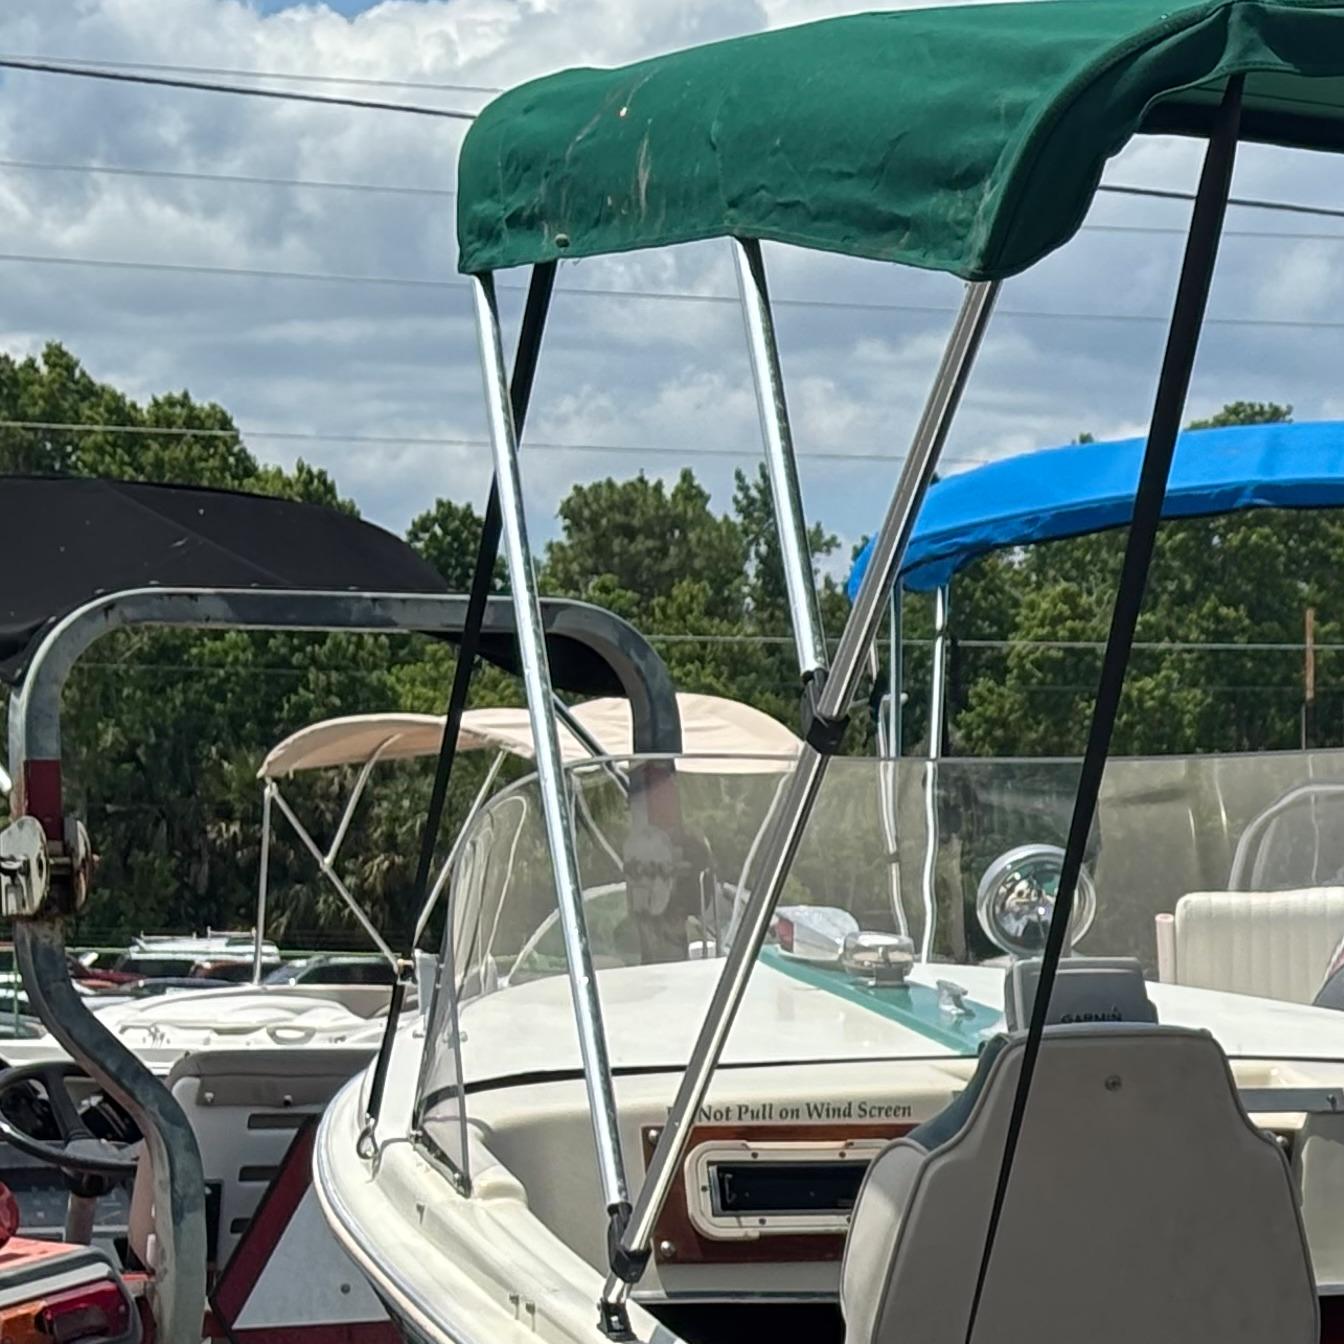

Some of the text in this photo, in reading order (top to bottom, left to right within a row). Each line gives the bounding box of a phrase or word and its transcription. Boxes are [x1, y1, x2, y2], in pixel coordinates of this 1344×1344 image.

[700, 1105, 732, 1122] Not
[737, 1103, 773, 1121] Pull
[779, 1107, 800, 1120] on
[806, 1101, 853, 1120] Wind
[857, 1101, 912, 1119] Screen
